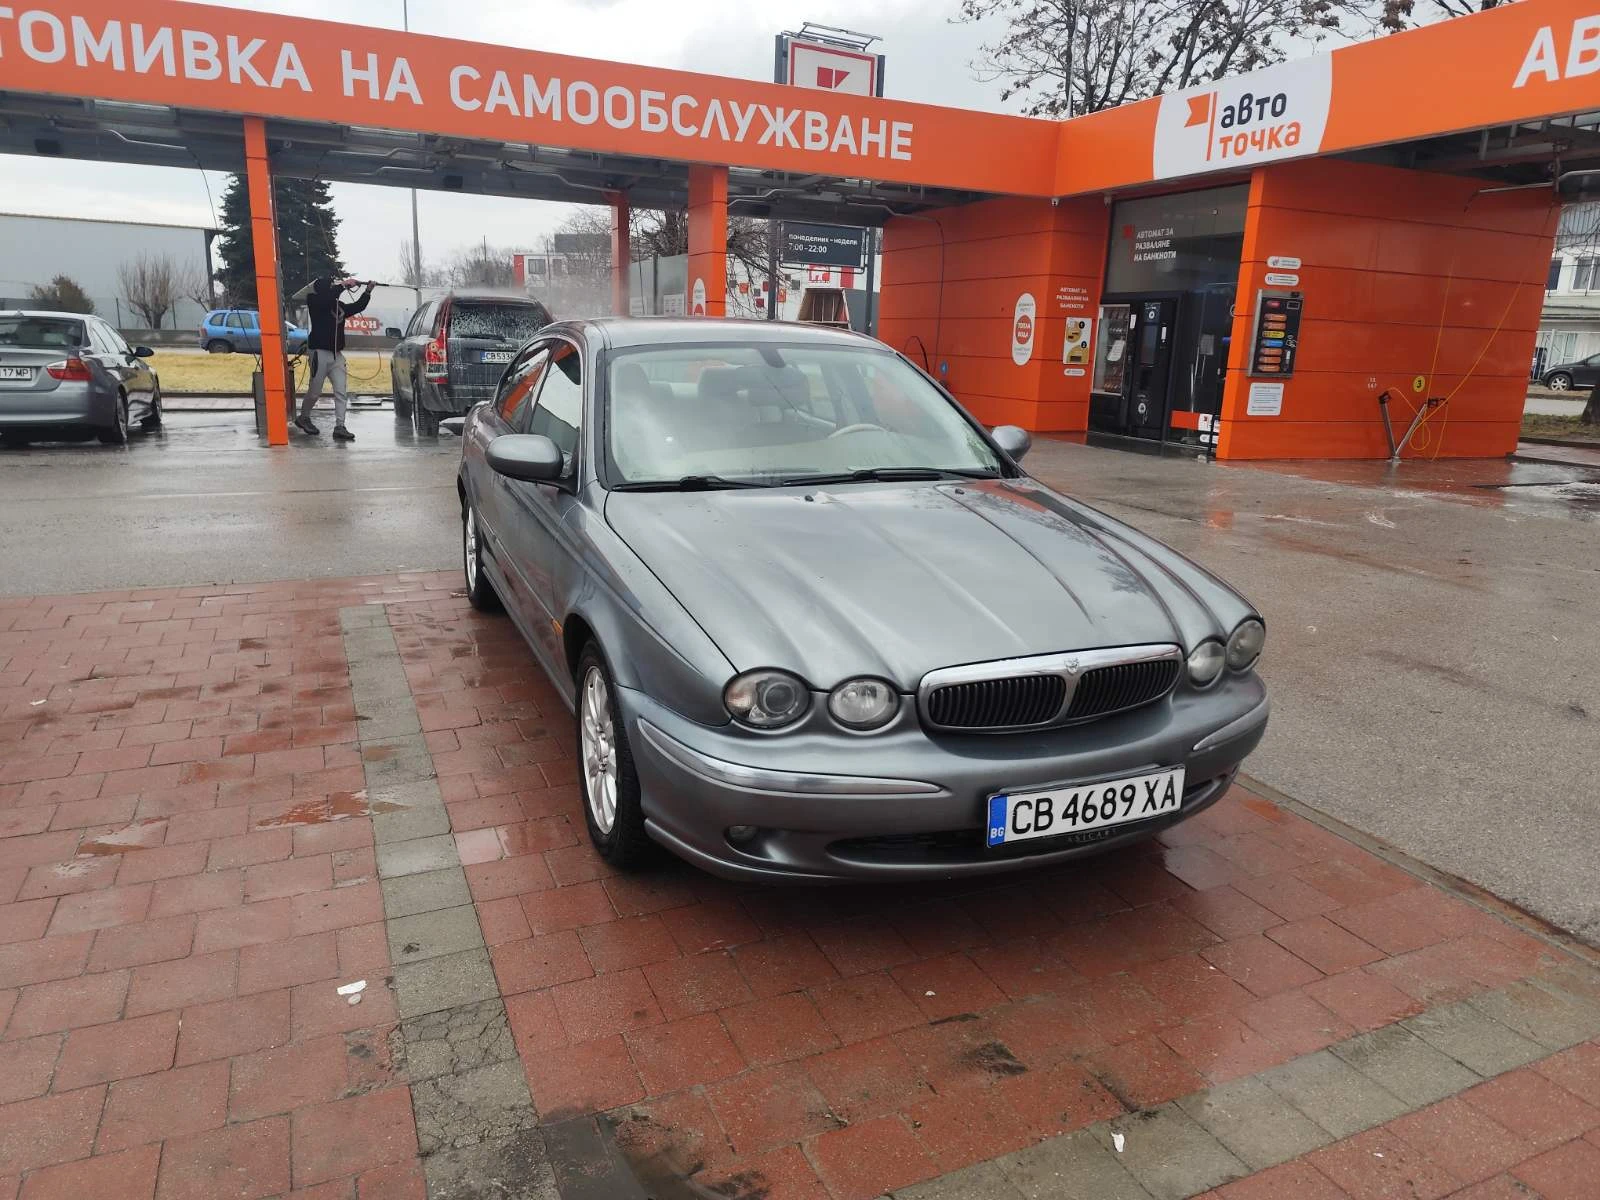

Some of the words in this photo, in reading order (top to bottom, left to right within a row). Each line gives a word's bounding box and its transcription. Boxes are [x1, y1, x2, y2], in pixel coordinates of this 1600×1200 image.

[1512, 13, 1600, 88] АВ
[342, 50, 423, 105] НА
[449, 65, 913, 161] САМООБСЛУЖВАНЕ
[1220, 92, 1287, 128] авто
[1219, 121, 1301, 159] точка
[1135, 240, 1171, 250] РАЗВАЛЯНЕ
[1143, 250, 1177, 261] БАНКНОТИ
[1011, 797, 1054, 835] CB
[1062, 784, 1136, 827] 4689
[1142, 773, 1176, 814] XA
[990, 827, 1005, 839] BG
